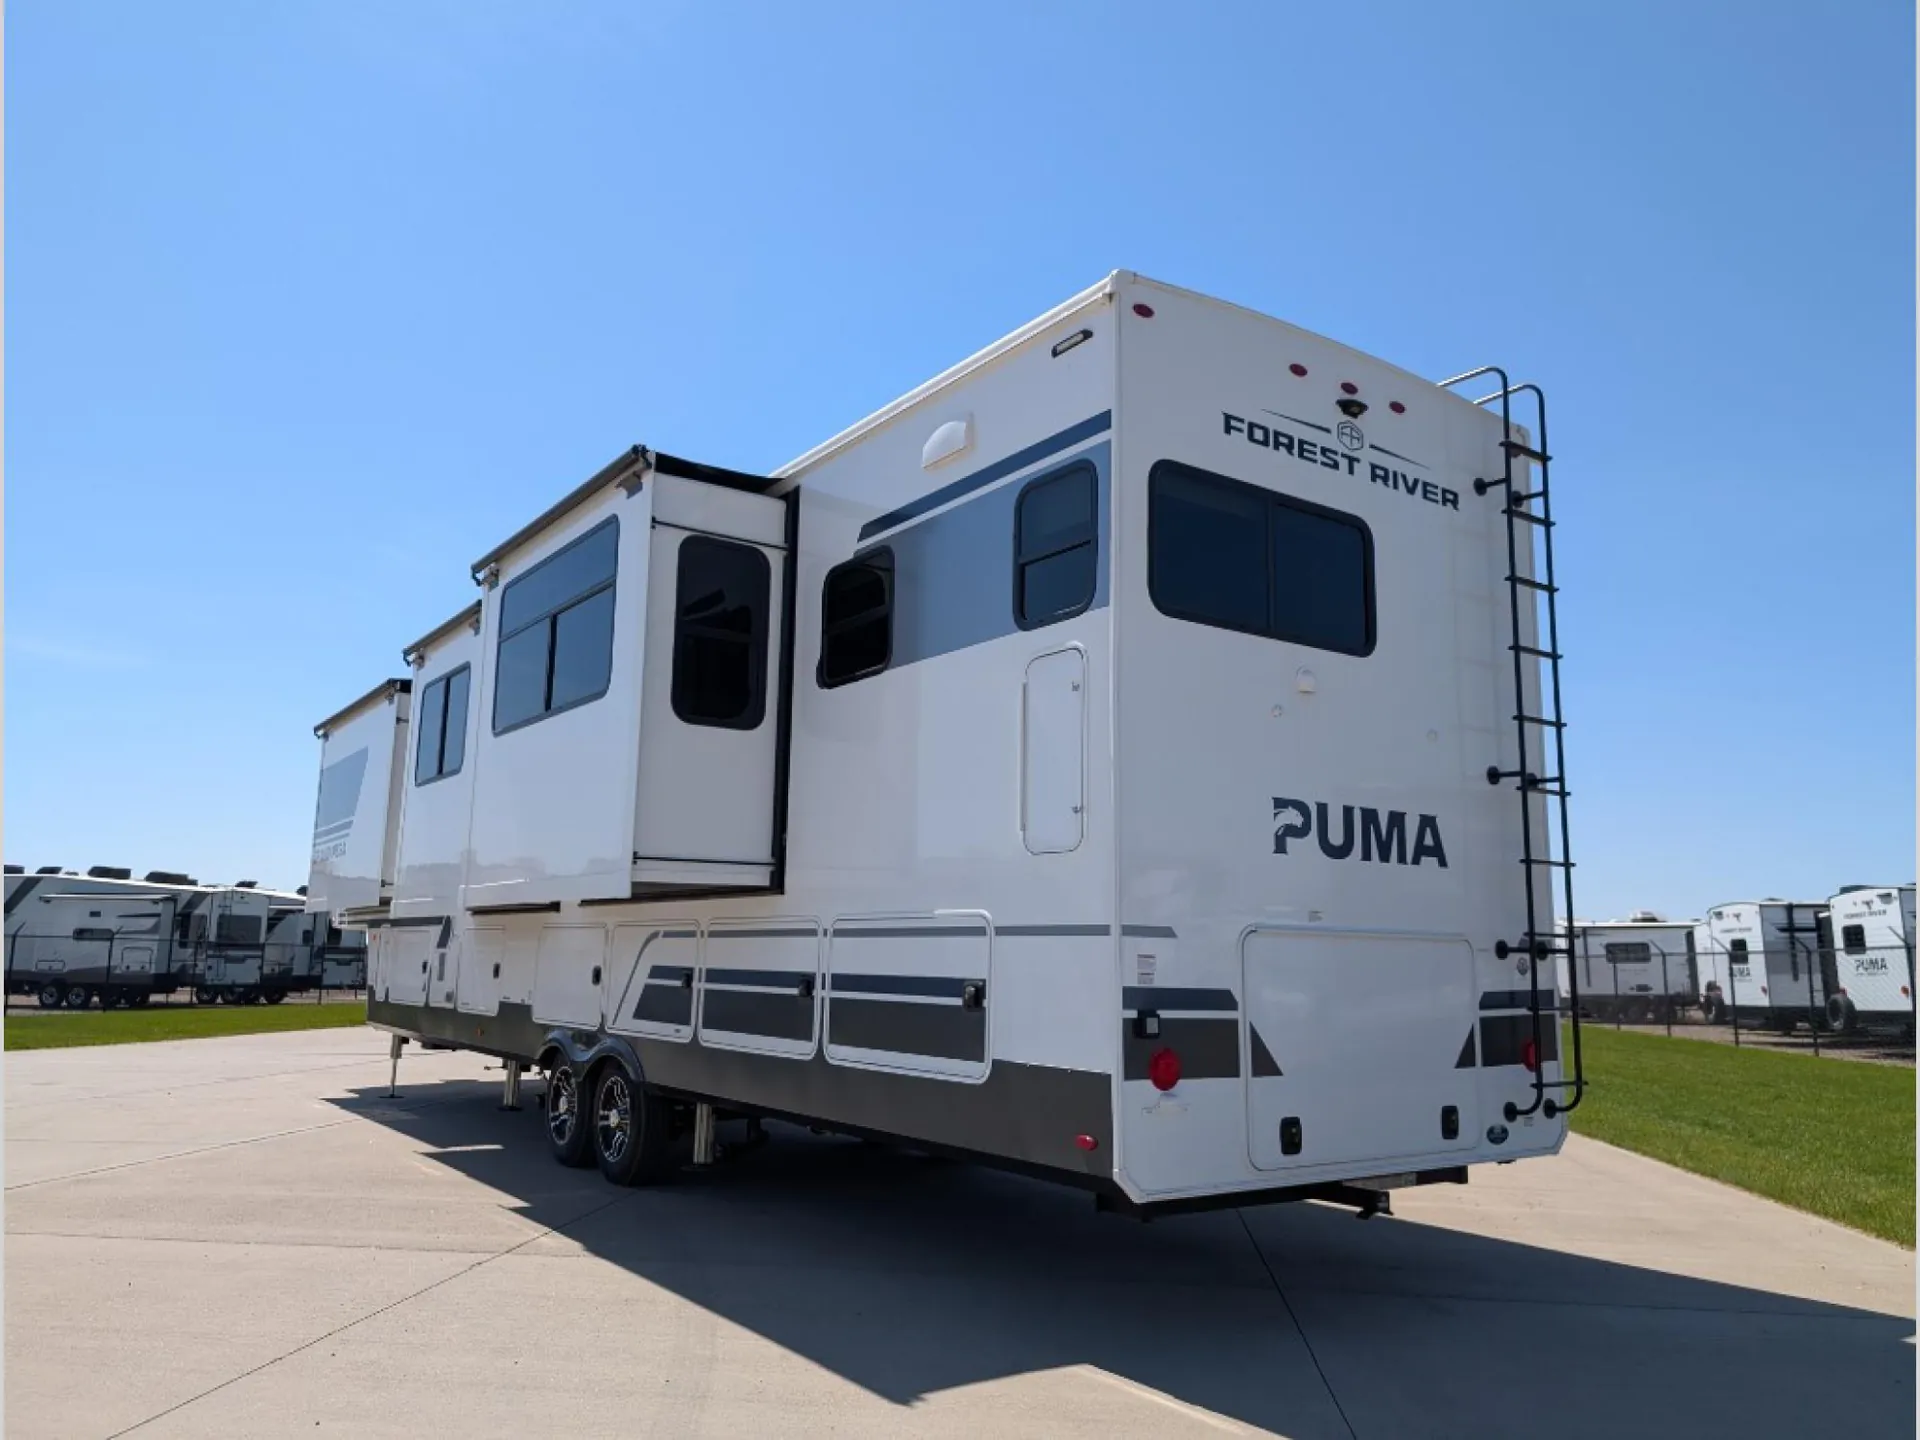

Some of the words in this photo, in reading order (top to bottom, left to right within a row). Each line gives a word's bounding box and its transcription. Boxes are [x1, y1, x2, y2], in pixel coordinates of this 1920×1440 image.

[1222, 411, 1361, 476] FOREST
[1368, 461, 1460, 511] RIVER
[1271, 796, 1449, 868] PUMA
